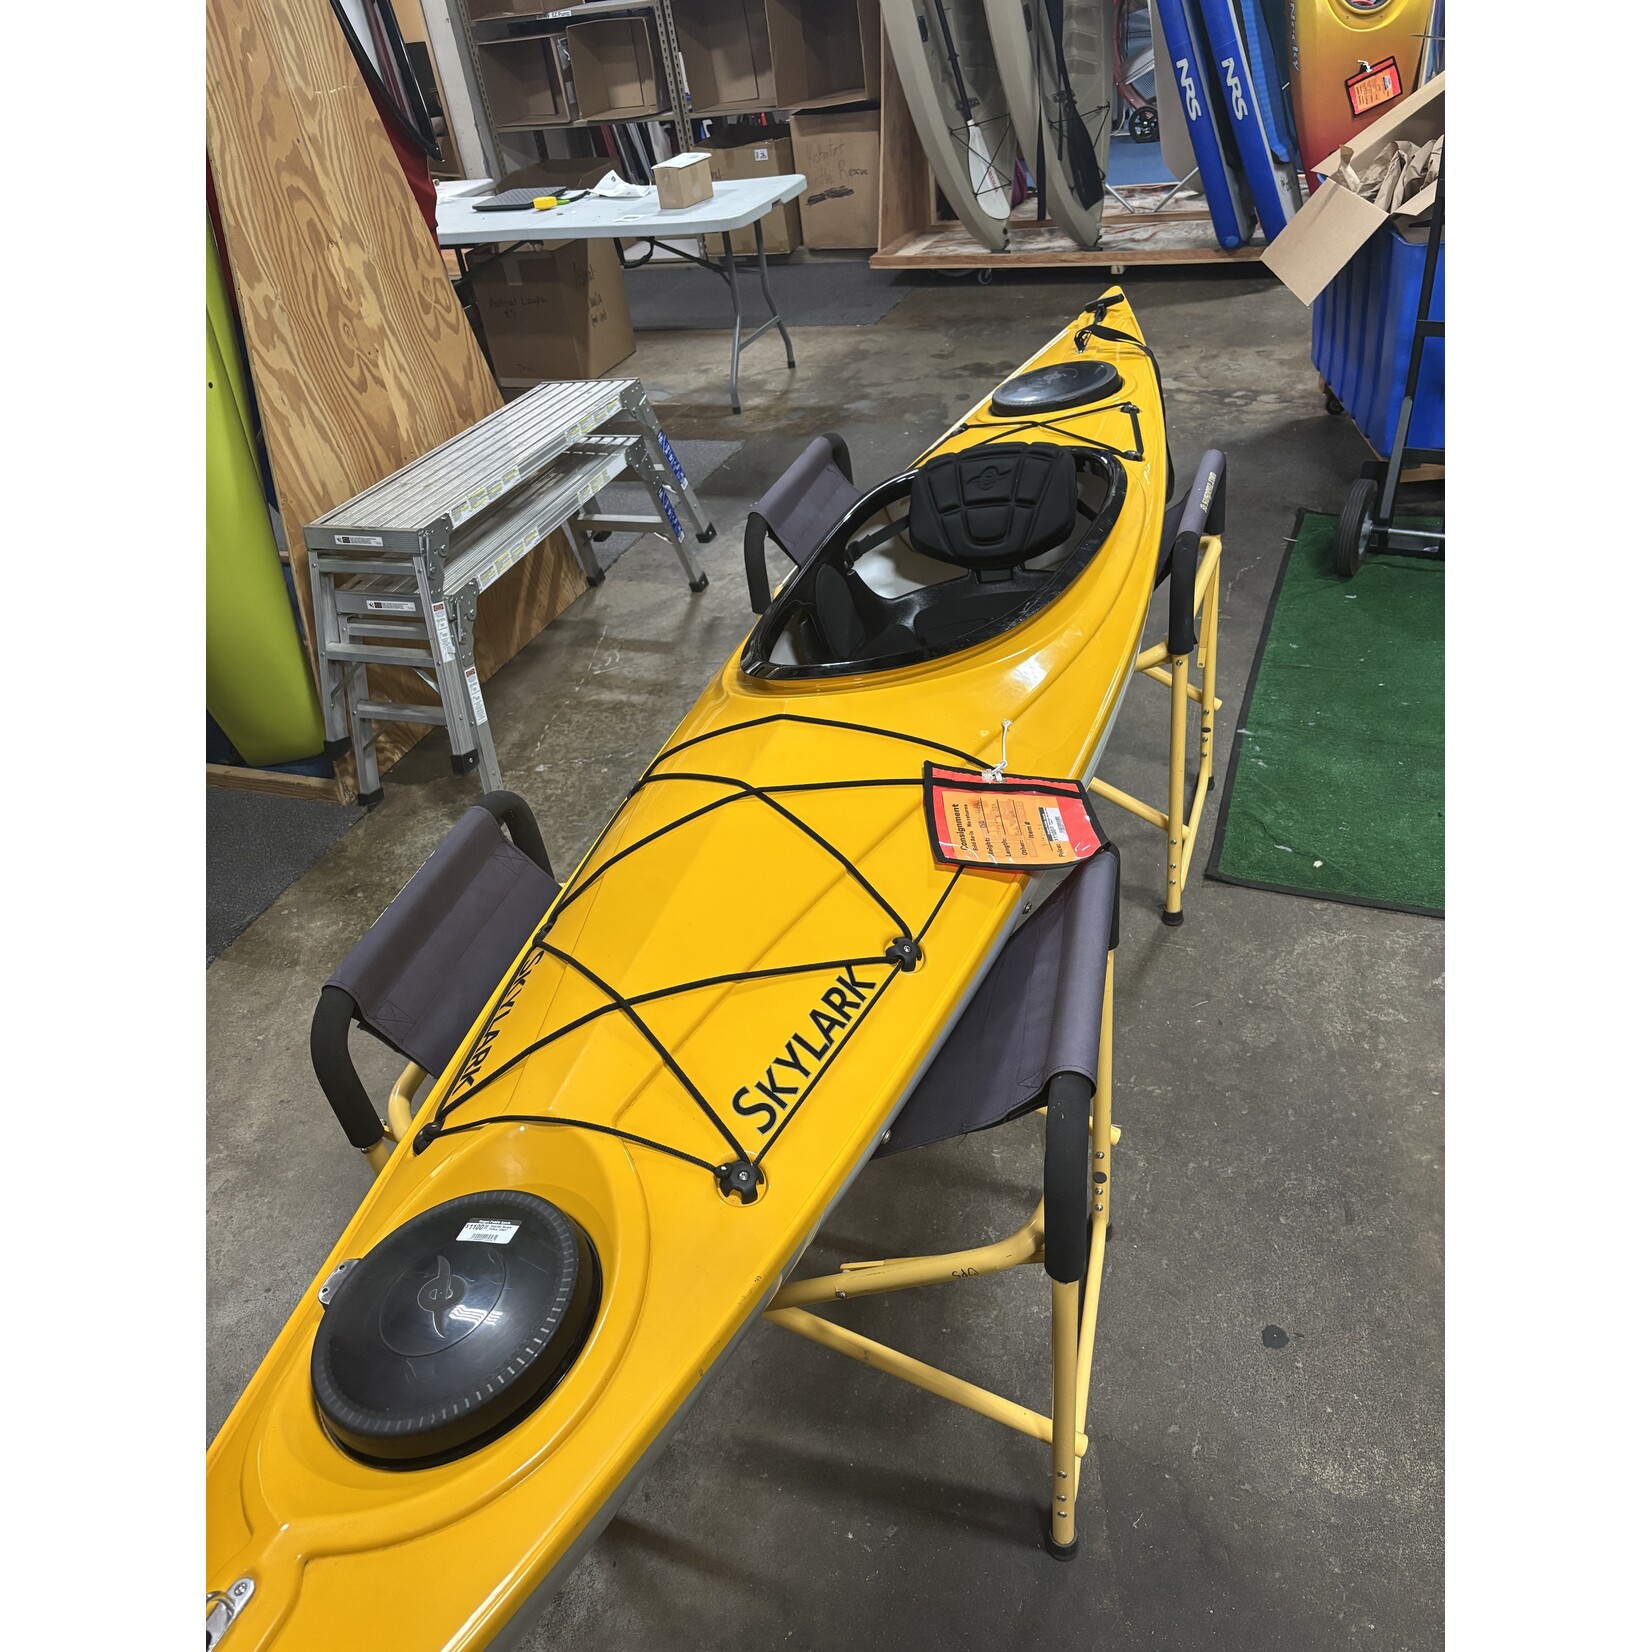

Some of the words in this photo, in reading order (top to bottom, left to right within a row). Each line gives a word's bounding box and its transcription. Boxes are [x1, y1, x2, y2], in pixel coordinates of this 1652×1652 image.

[1176, 58, 1202, 121] NRS
[1221, 57, 1248, 121] NRS
[952, 803, 968, 850] Consignment
[451, 950, 545, 1097] SKYLARK
[732, 964, 877, 1135] SKYLARK
